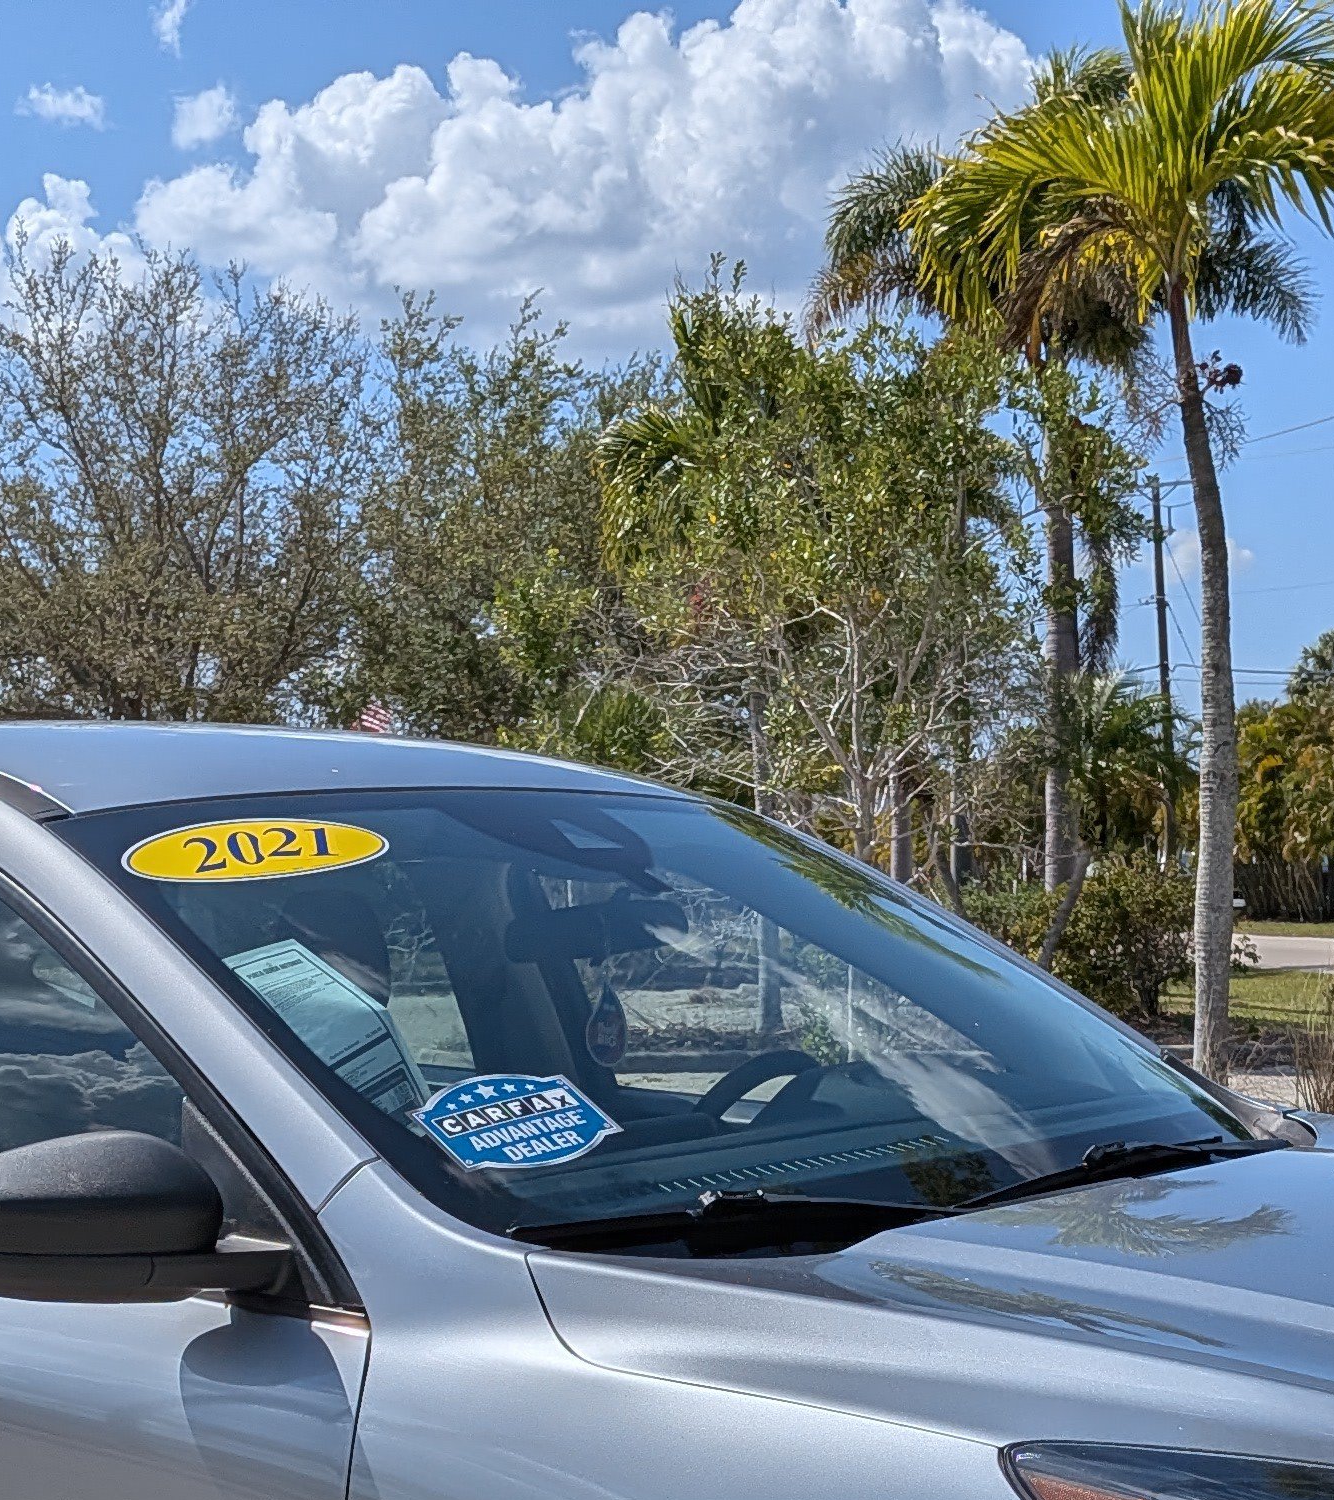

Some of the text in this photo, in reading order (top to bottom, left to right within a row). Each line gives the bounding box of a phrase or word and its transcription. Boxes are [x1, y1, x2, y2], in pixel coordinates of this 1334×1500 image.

[182, 827, 339, 874] 2021
[442, 1092, 575, 1134] CARFAX
[468, 1110, 588, 1152] ADVANTAGE
[501, 1131, 586, 1162] DEALER
